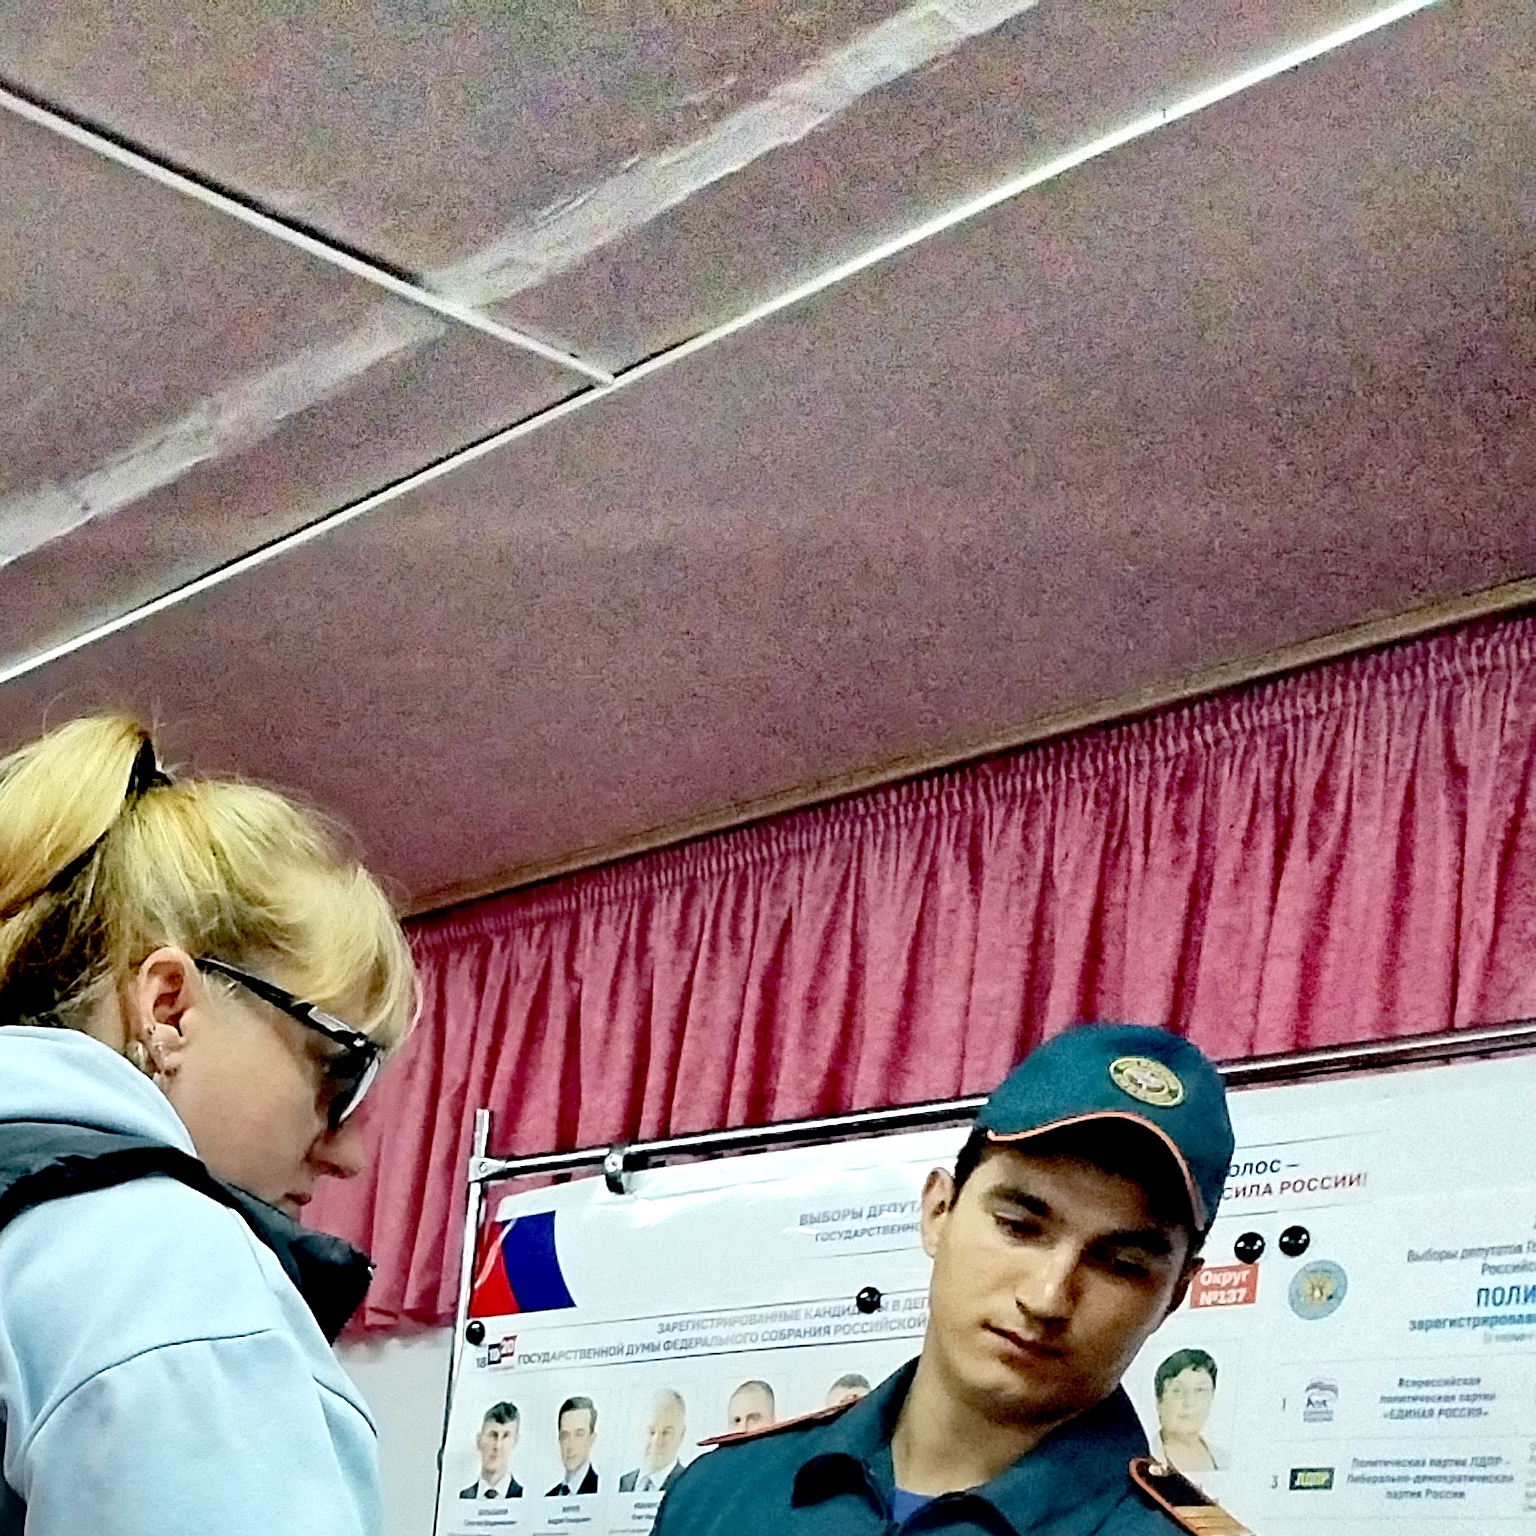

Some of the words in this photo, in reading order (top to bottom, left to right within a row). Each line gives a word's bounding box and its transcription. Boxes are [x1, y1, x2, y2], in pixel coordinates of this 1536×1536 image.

[1228, 1158, 1282, 1178] ОЛОС
[1222, 1182, 1273, 1200] СИЛА
[1279, 1172, 1368, 1195] РОССИИ!
[799, 1206, 864, 1226] ВЫБОРЫ
[1199, 1269, 1251, 1288] Округ
[517, 1344, 624, 1365] ГОСУДАРСТВЕННОЙ
[625, 1340, 661, 1357] ДУМЫ
[662, 1331, 759, 1351] ФЕДЕРАЛЬНОГО
[760, 1324, 831, 1342] СОБРАНИЯ
